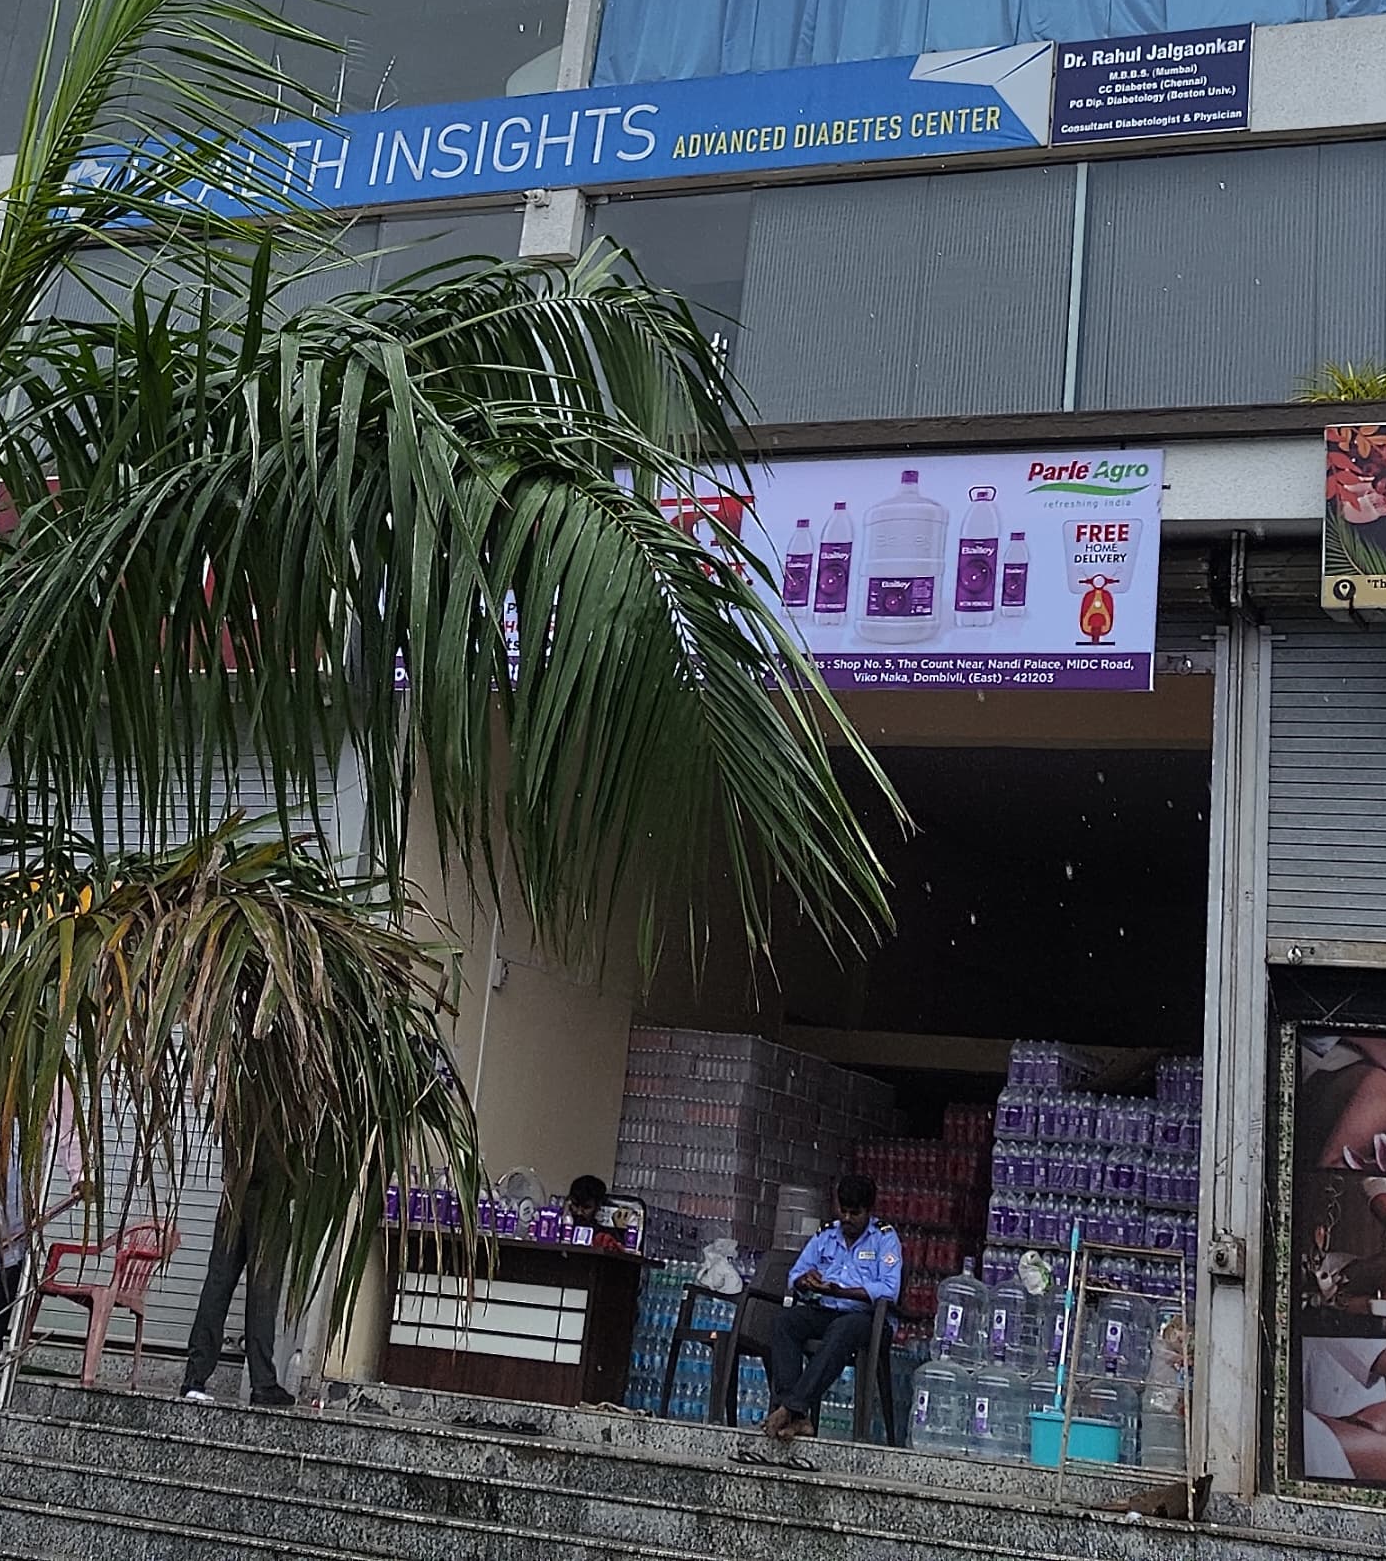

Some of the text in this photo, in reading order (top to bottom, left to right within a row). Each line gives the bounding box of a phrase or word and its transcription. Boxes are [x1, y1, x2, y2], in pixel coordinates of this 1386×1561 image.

[1063, 38, 1246, 69] Dr. Rahul Jalgaonkar
[1152, 64, 1198, 78] (Mumbai)
[1098, 76, 1208, 94] CC Diabetes (Chennai)
[1107, 92, 1164, 106] Diabetology
[1167, 87, 1205, 102] (Boston
[1208, 85, 1237, 97] Univ.)
[1061, 109, 1243, 134] Consultant Diabetologist & Physician
[672, 106, 1001, 159] ADVANCED DIABETES CENTER
[367, 103, 660, 186] INSIGHTS
[1093, 460, 1149, 483] Agro
[1076, 524, 1130, 542] FREE
[1085, 543, 1118, 553] HOME
[1074, 553, 1127, 564] DELIVERY
[834, 659, 861, 671] Shop
[864, 659, 882, 669] No.
[884, 659, 895, 670] 5,
[897, 659, 918, 669] The
[920, 659, 954, 669] Count
[956, 659, 985, 670] Near,
[988, 659, 1021, 669] Nandi
[1024, 659, 1063, 670] Palace,
[1067, 659, 1098, 669] MIDC
[1101, 659, 1134, 670] Road,
[854, 672, 878, 683] Viko
[880, 672, 910, 684] Naka,
[913, 672, 965, 684] Dombivli,
[968, 672, 1002, 684] (East)
[1013, 672, 1054, 683] 421203
